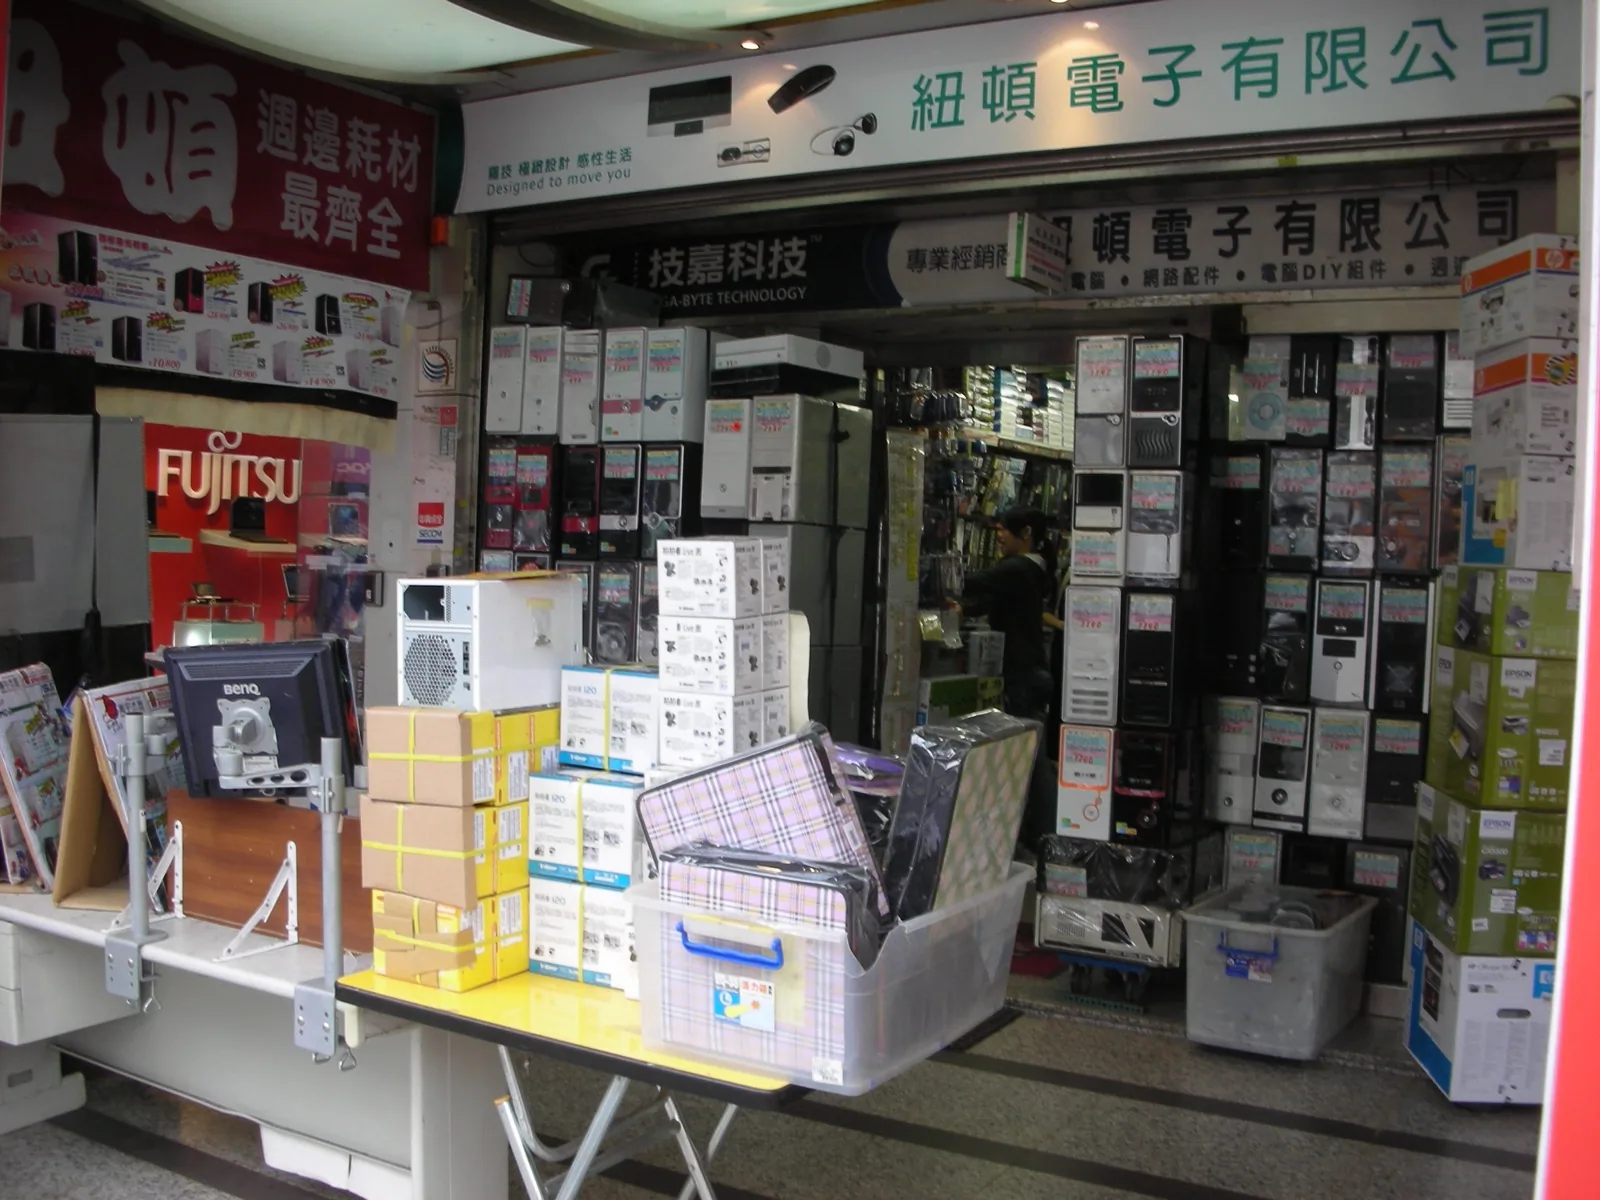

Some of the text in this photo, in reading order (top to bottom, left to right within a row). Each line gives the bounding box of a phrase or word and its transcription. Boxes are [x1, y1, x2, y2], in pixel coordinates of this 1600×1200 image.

[257, 88, 422, 193] 週邊耗材
[577, 147, 632, 168] 感性生活
[487, 167, 631, 196] Designed to move you
[281, 173, 403, 260] 最齊全
[649, 235, 808, 288] 技嘉科技
[717, 286, 807, 305] TECHNOLOGY
[157, 447, 302, 516] FUJITSU
[1503, 669, 1532, 679] EPSON
[223, 682, 261, 696] BenQ
[1483, 817, 1512, 828] EPSON
